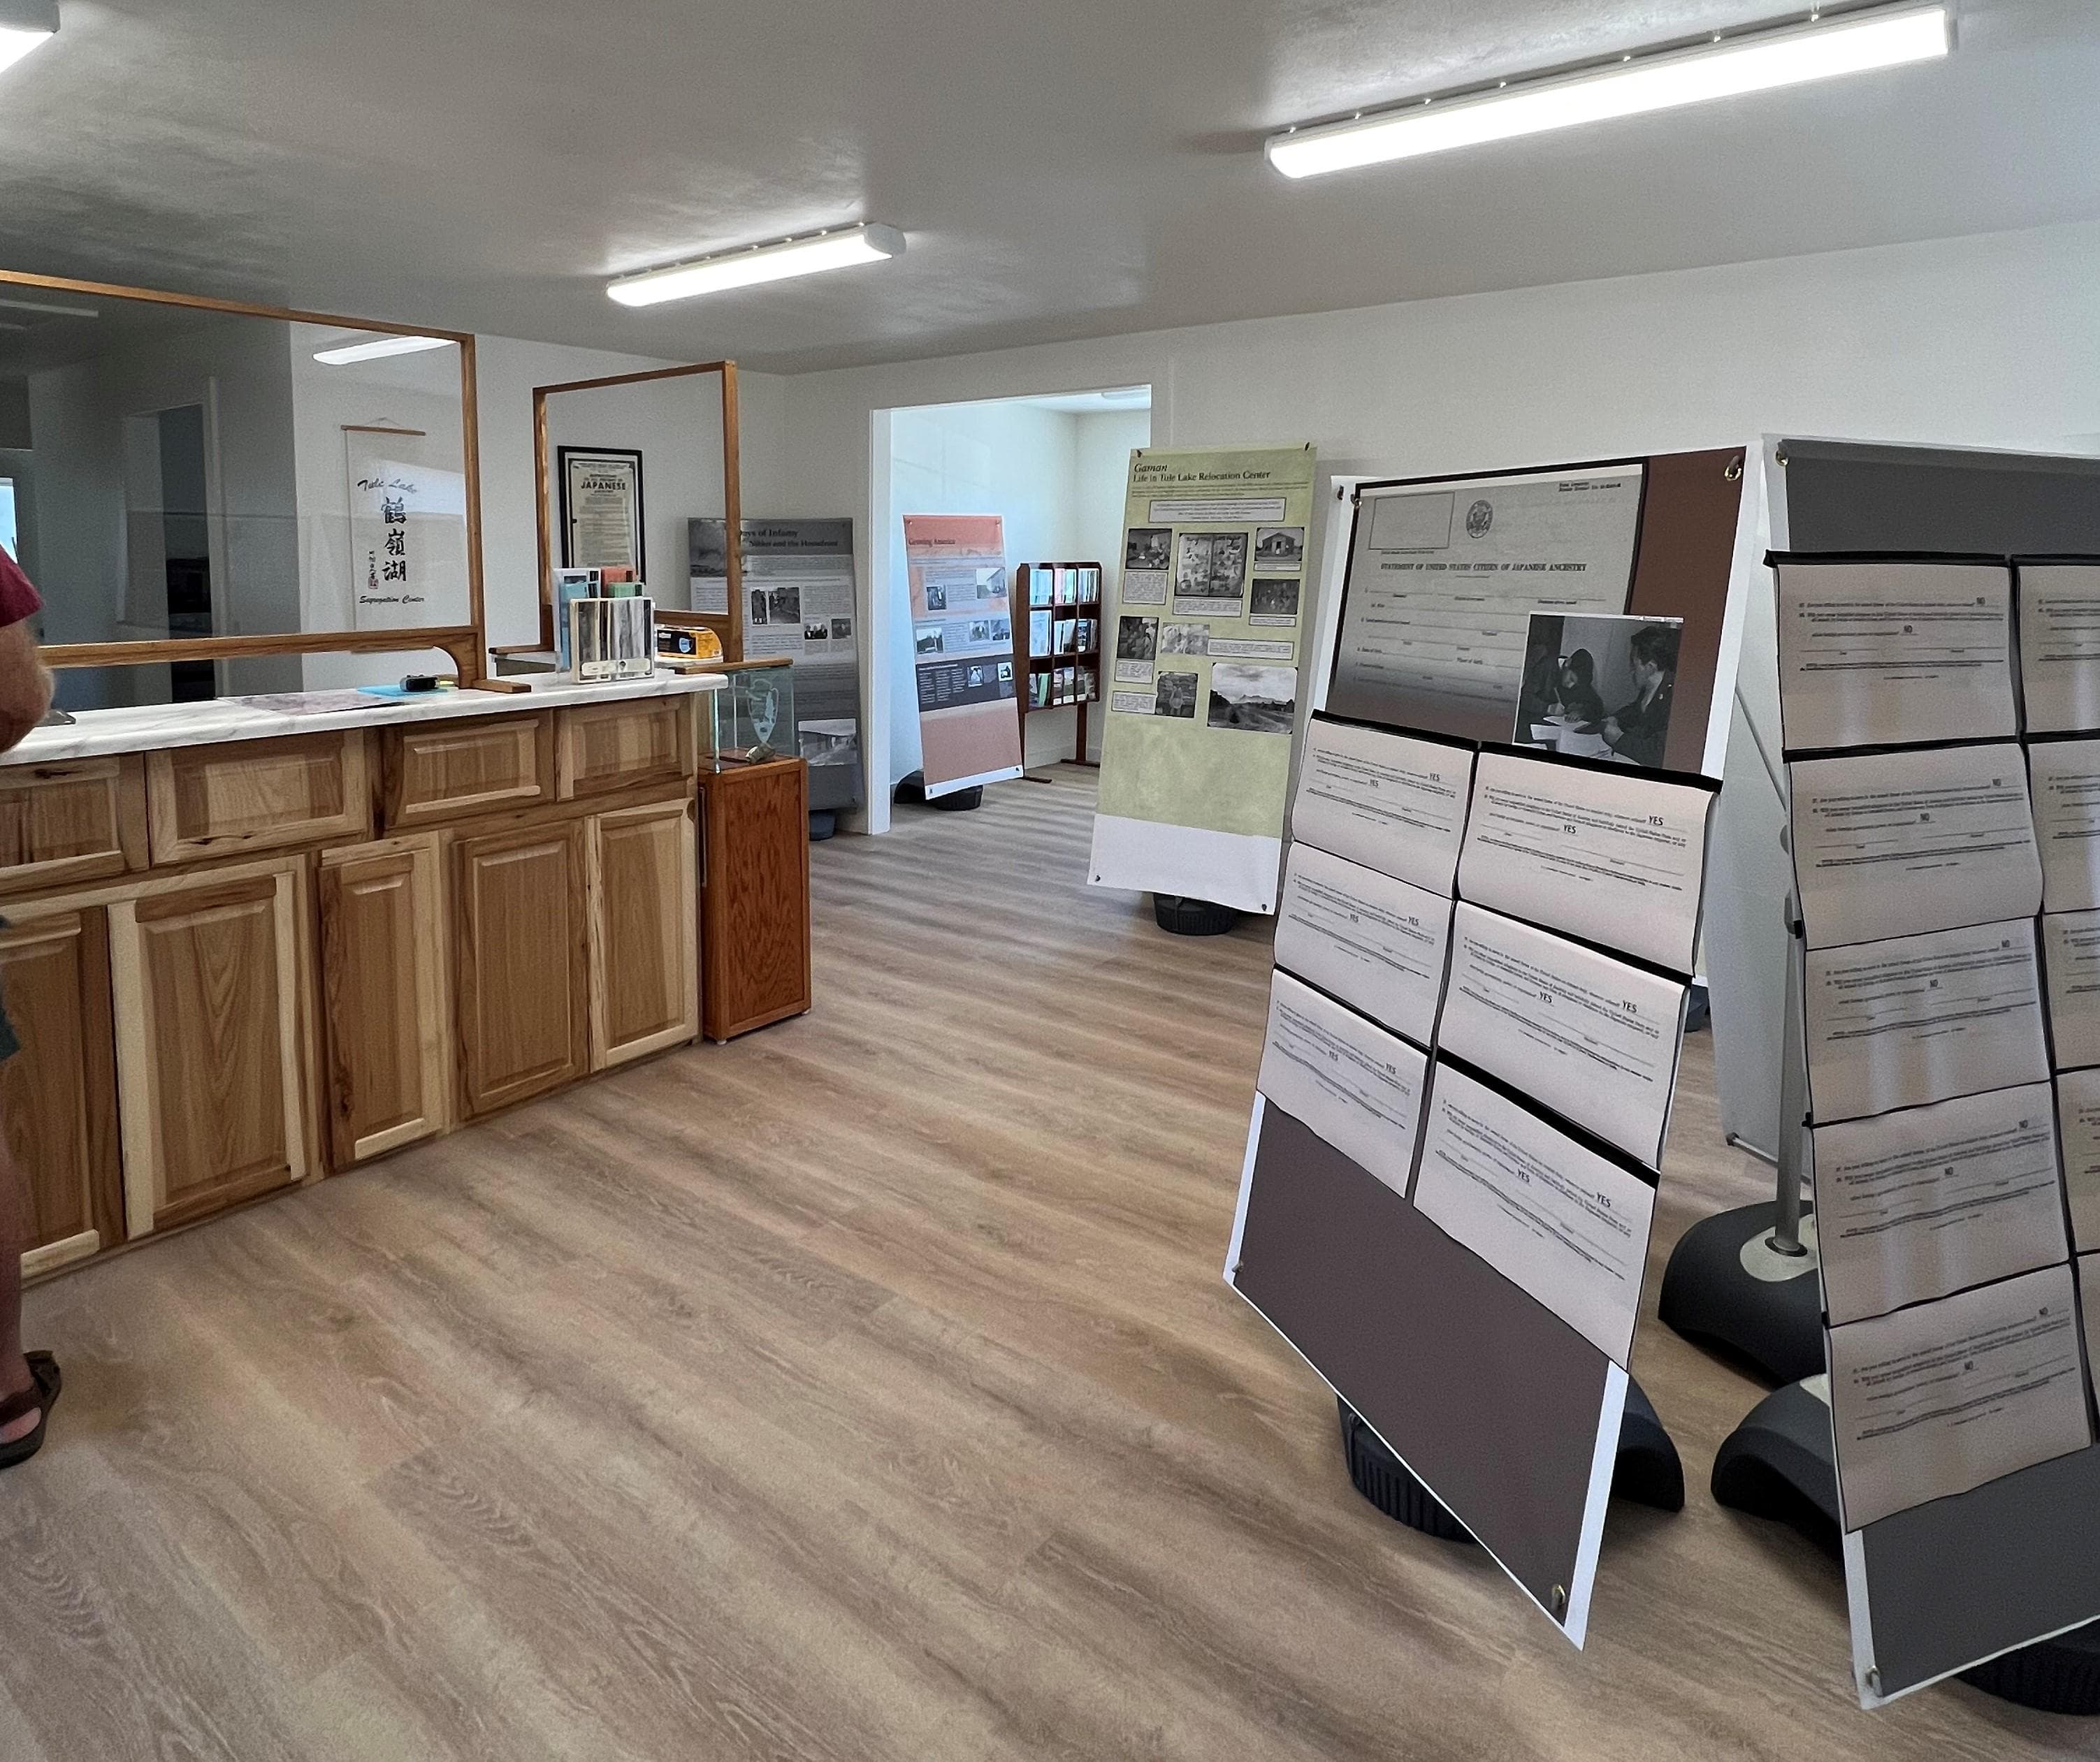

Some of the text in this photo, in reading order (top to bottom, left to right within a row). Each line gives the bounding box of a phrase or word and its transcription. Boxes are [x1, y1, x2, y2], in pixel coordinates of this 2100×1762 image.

[1134, 463, 1168, 472] Gaman
[1133, 473, 1148, 482] Life
[1161, 474, 1175, 482] Tule
[1178, 473, 1196, 481] Lake
[1199, 472, 1240, 481] Relocation
[1242, 470, 1271, 479] Center
[581, 481, 626, 490] JAPANESE
[769, 529, 799, 538] Infamy
[1429, 772, 1440, 782] YES
[1369, 779, 1380, 787] YES
[1649, 815, 1664, 826] YES
[1563, 824, 1577, 834] YES
[1349, 913, 1359, 923] YES
[1407, 916, 1419, 926] YES
[1539, 991, 1553, 1003] YES
[1623, 1000, 1637, 1014] YES
[1328, 1050, 1339, 1062] YES
[1386, 1063, 1397, 1075] YES
[1517, 1168, 1530, 1183] YES
[1597, 1192, 1611, 1208] YES
